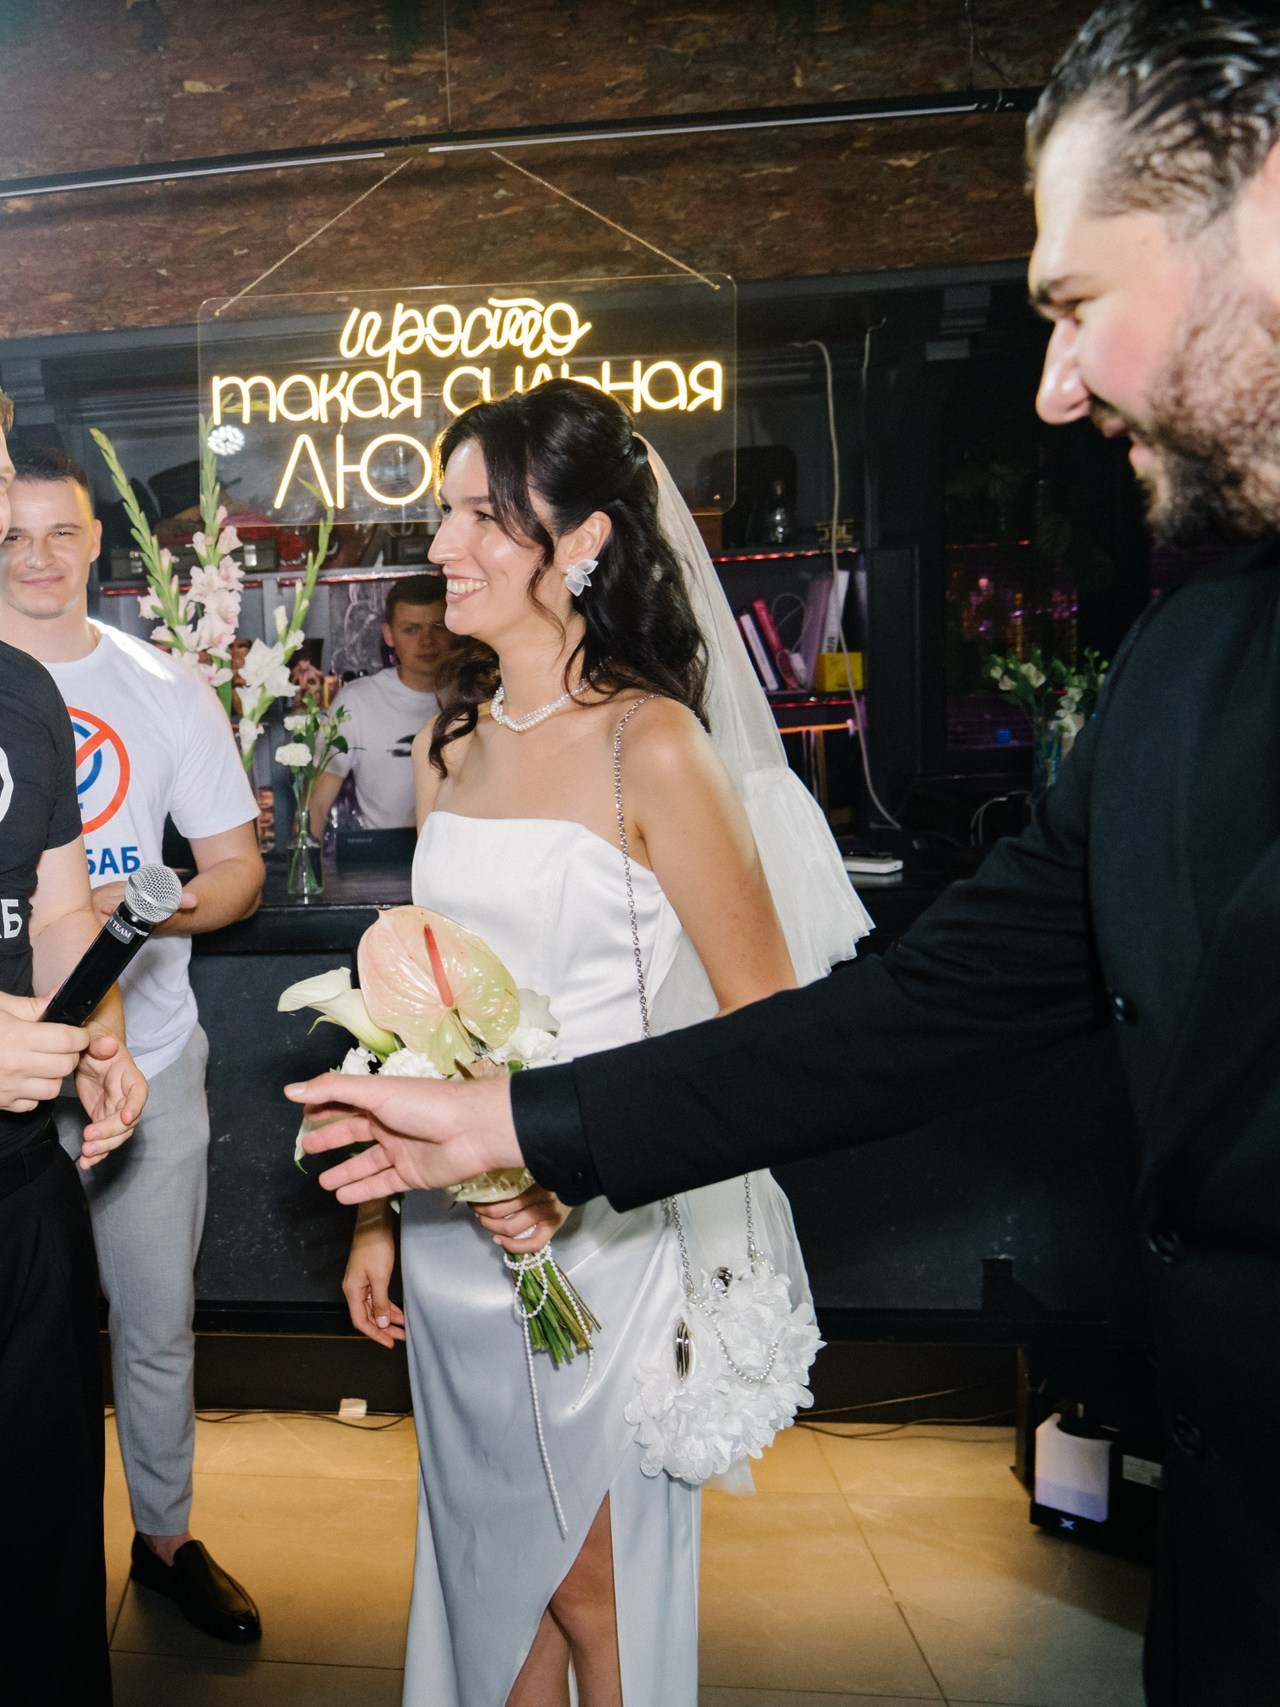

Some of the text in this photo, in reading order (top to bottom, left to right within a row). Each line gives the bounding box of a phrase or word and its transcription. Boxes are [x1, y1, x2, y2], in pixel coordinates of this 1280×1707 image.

[339, 296, 593, 379] просто
[211, 368, 423, 426] такая
[112, 920, 132, 939] TEAM
